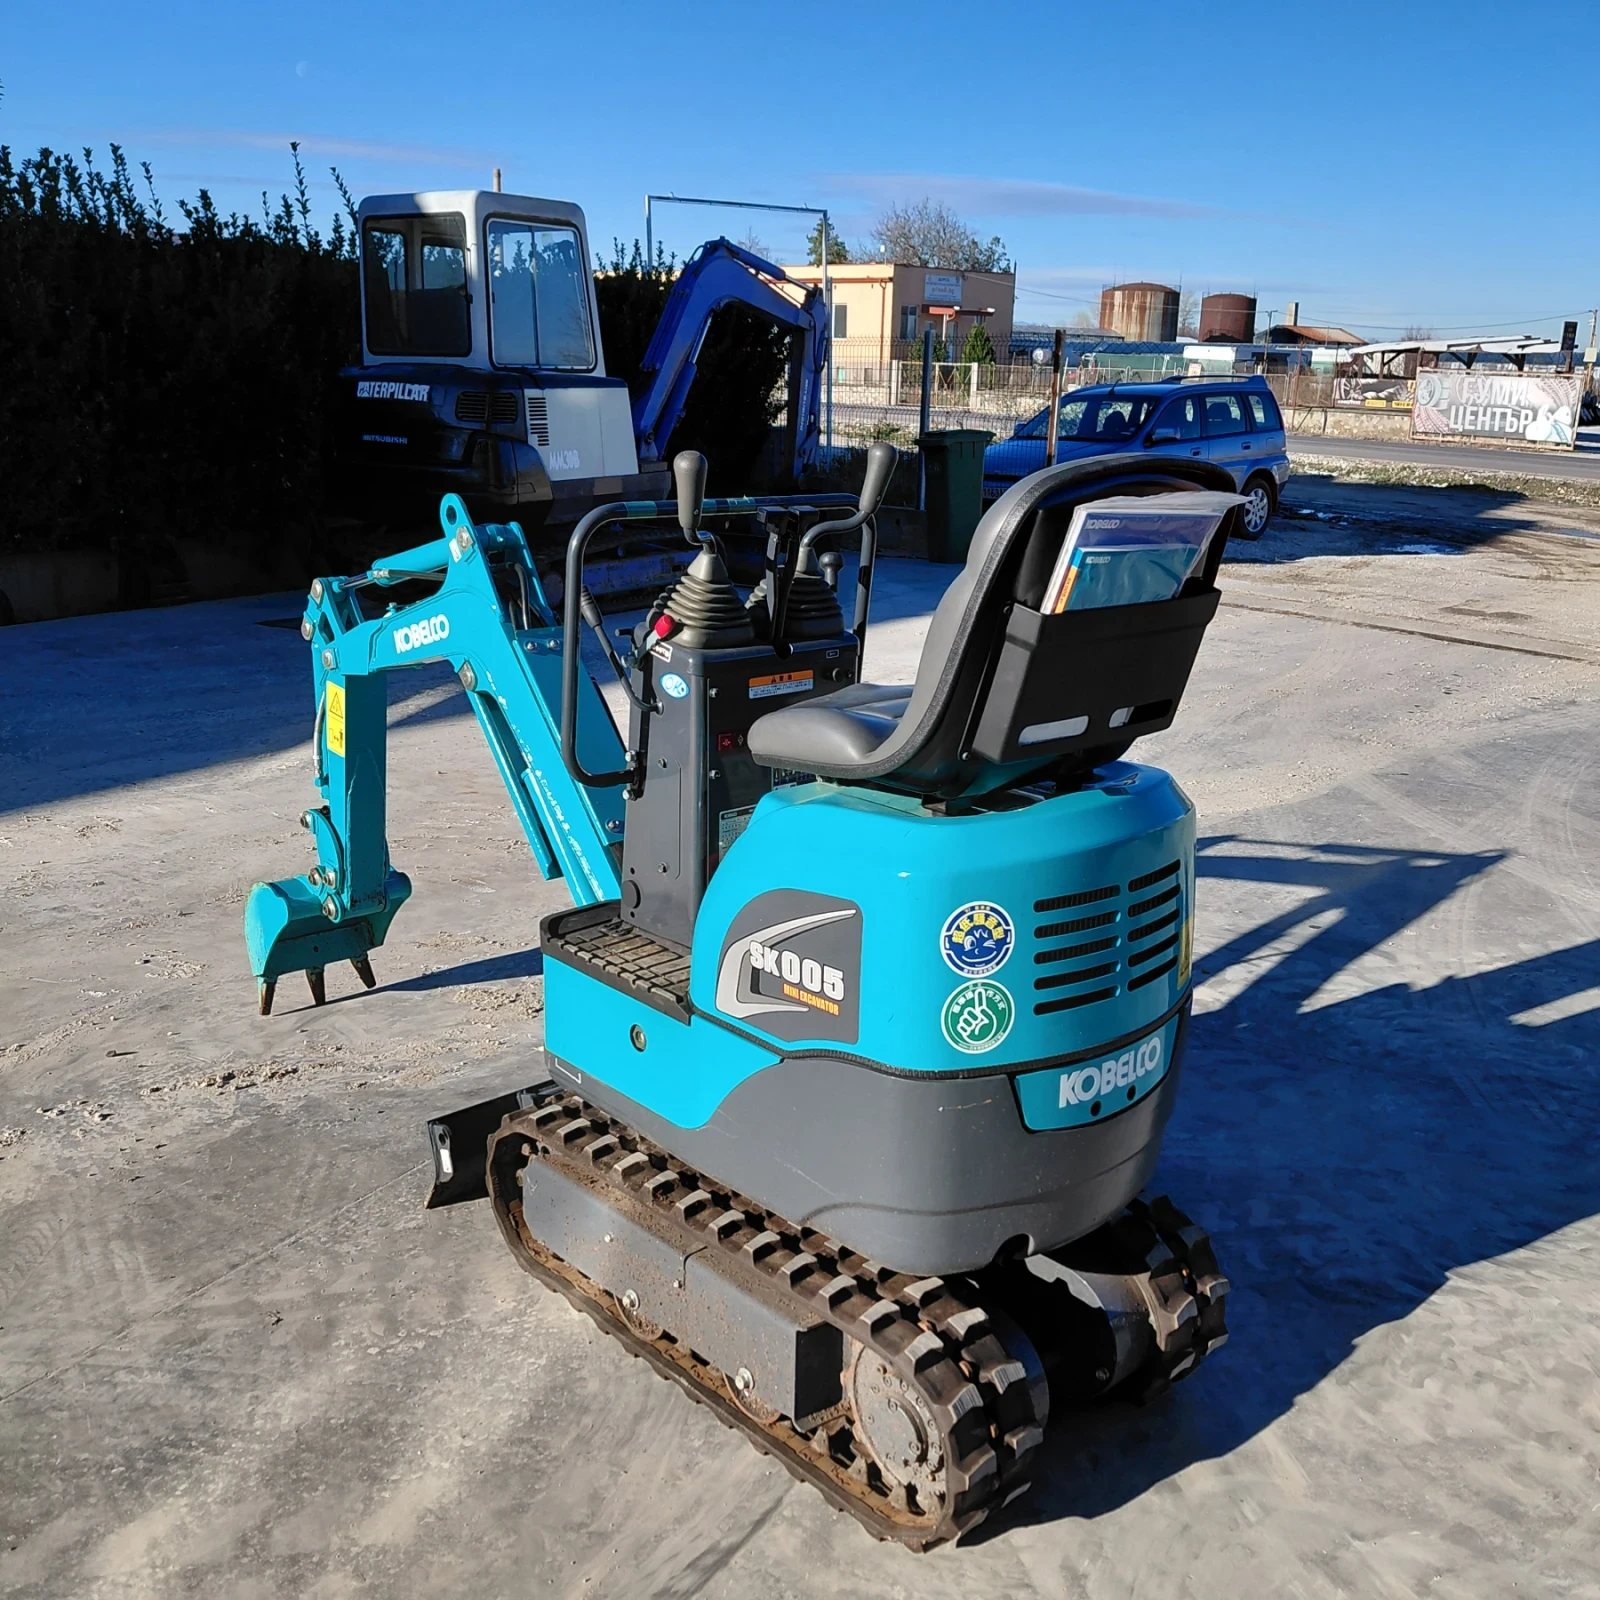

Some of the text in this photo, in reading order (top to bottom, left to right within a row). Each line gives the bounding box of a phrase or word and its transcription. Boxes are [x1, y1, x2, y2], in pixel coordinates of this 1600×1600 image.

[1461, 376, 1529, 407] ГУМИ
[1449, 404, 1534, 434] ЦЕНТЪР
[362, 434, 408, 445] MITSUBISHI
[1085, 519, 1120, 529] KOBELCO
[393, 613, 450, 654] KOBELCO
[749, 939, 845, 1002] SK005
[783, 983, 840, 1016] MINI EXCAVATOR
[1059, 1036, 1161, 1109] KOBELCO
